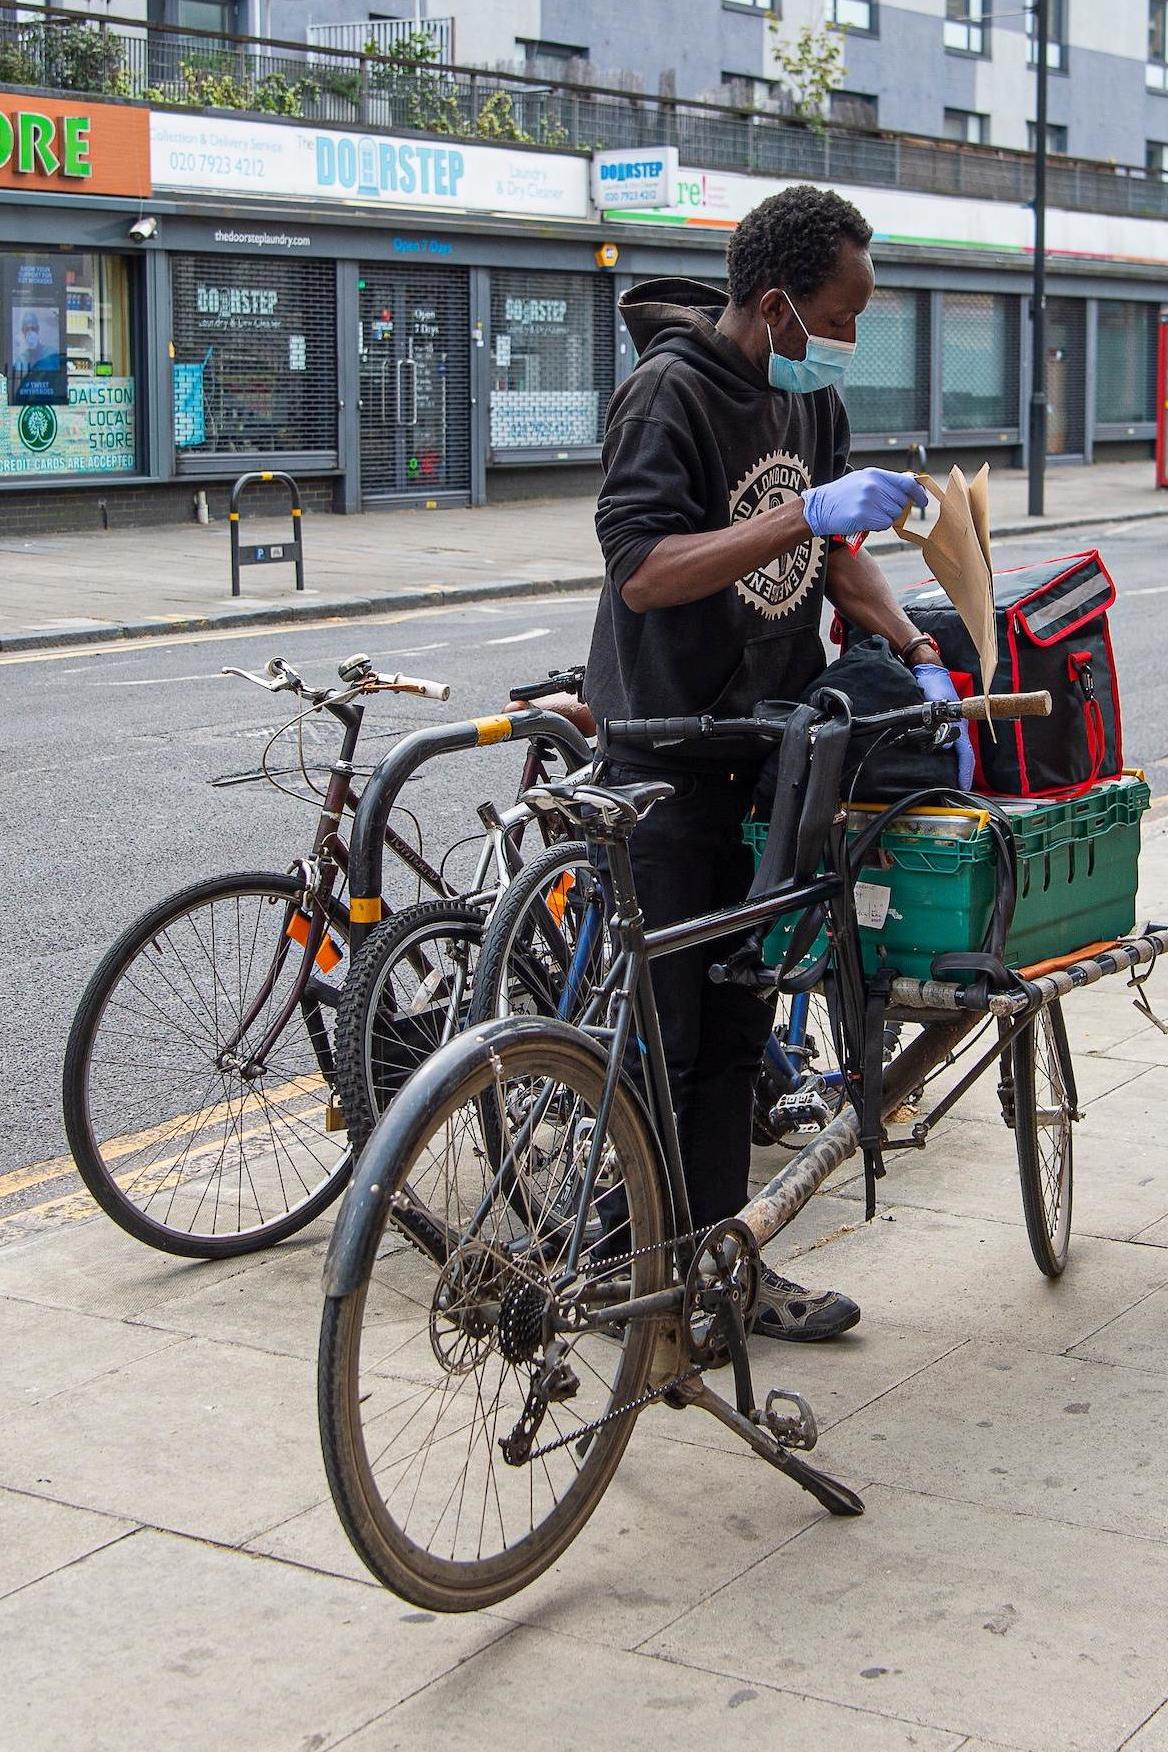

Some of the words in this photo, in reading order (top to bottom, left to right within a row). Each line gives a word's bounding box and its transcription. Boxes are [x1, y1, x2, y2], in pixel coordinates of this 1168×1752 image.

[200, 133, 207, 144] &
[296, 134, 313, 150] The
[170, 151, 196, 171] 020
[198, 153, 231, 174] 7923
[234, 157, 265, 178] 4212
[509, 161, 547, 184] Laundry
[497, 180, 504, 195] &
[507, 181, 525, 200] Dry
[527, 183, 564, 199] Cleaner
[215, 230, 310, 247] thedoorsteplaundry.com
[69, 388, 133, 405] DALSTON
[88, 410, 133, 426] LOCAL
[89, 432, 133, 449] STORE
[34, 457, 65, 471] CARDS
[68, 456, 85, 469] ARE
[88, 454, 134, 469] ACCEPTED
[753, 466, 801, 500] LONDON
[256, 548, 265, 560] P
